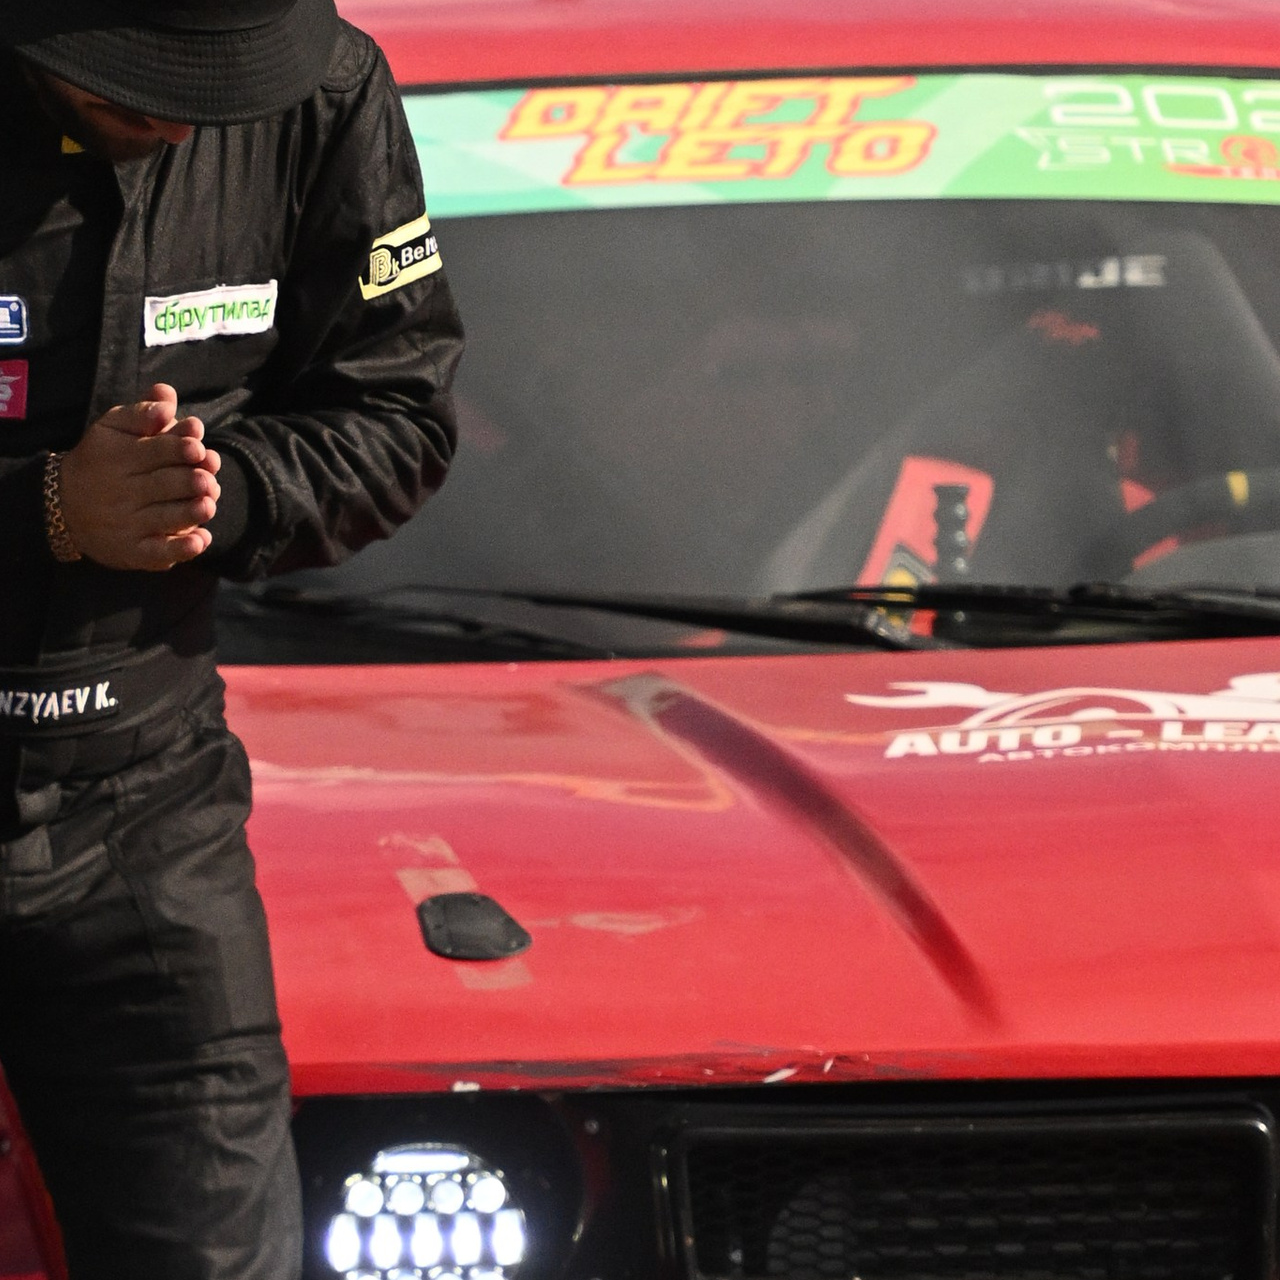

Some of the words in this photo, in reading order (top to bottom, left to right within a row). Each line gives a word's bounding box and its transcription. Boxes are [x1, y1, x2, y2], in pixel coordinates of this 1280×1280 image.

[497, 75, 919, 141] DRIFT
[561, 119, 938, 187] LETO
[95, 680, 118, 711] K.
[884, 723, 1082, 759] AUTO
